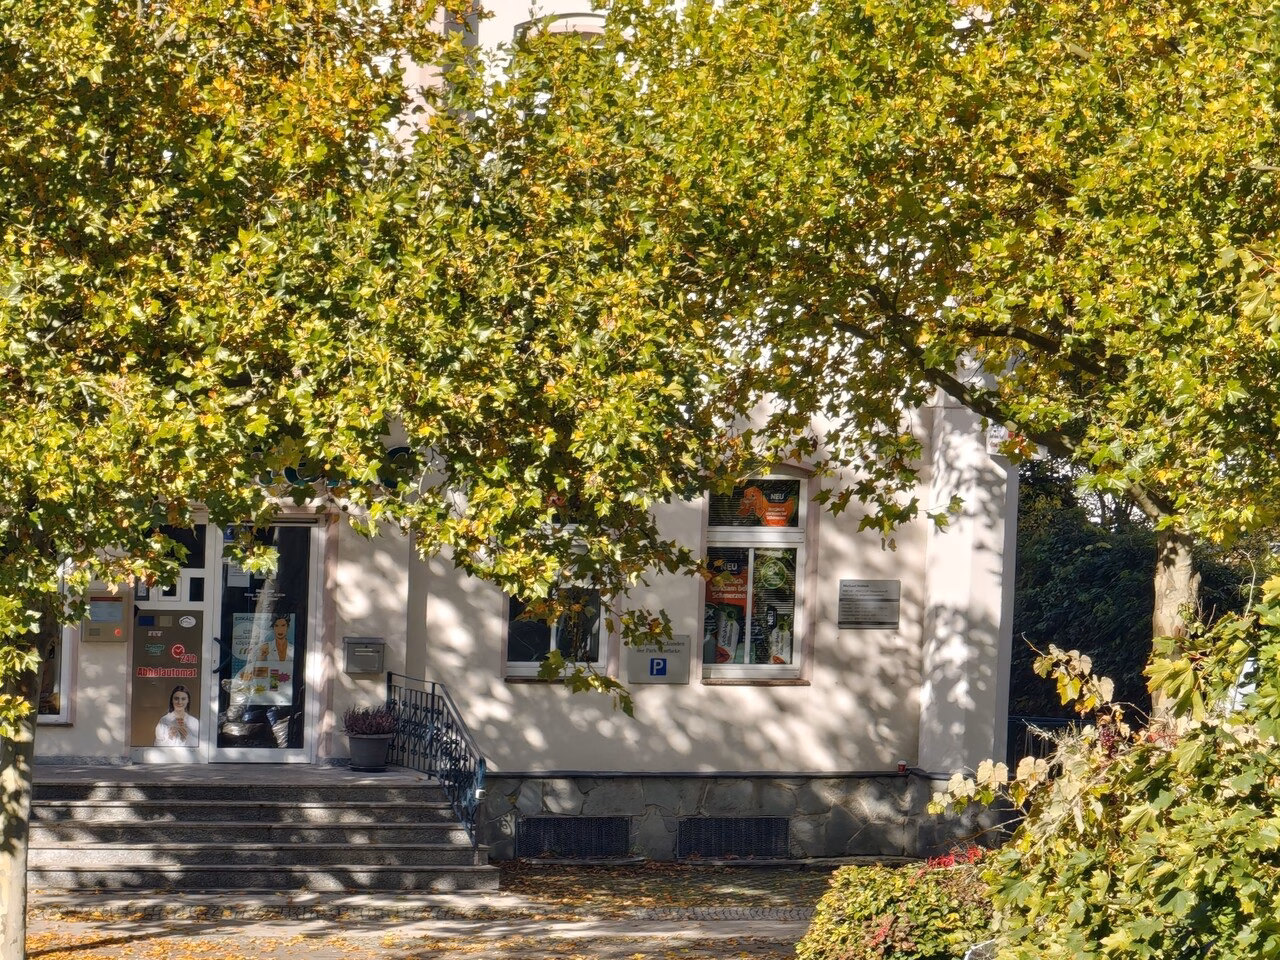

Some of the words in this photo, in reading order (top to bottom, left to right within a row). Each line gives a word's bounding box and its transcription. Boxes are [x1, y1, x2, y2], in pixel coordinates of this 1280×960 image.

[881, 537, 897, 552] 14
[721, 562, 738, 571] NEU
[136, 666, 198, 678] Abholautomat
